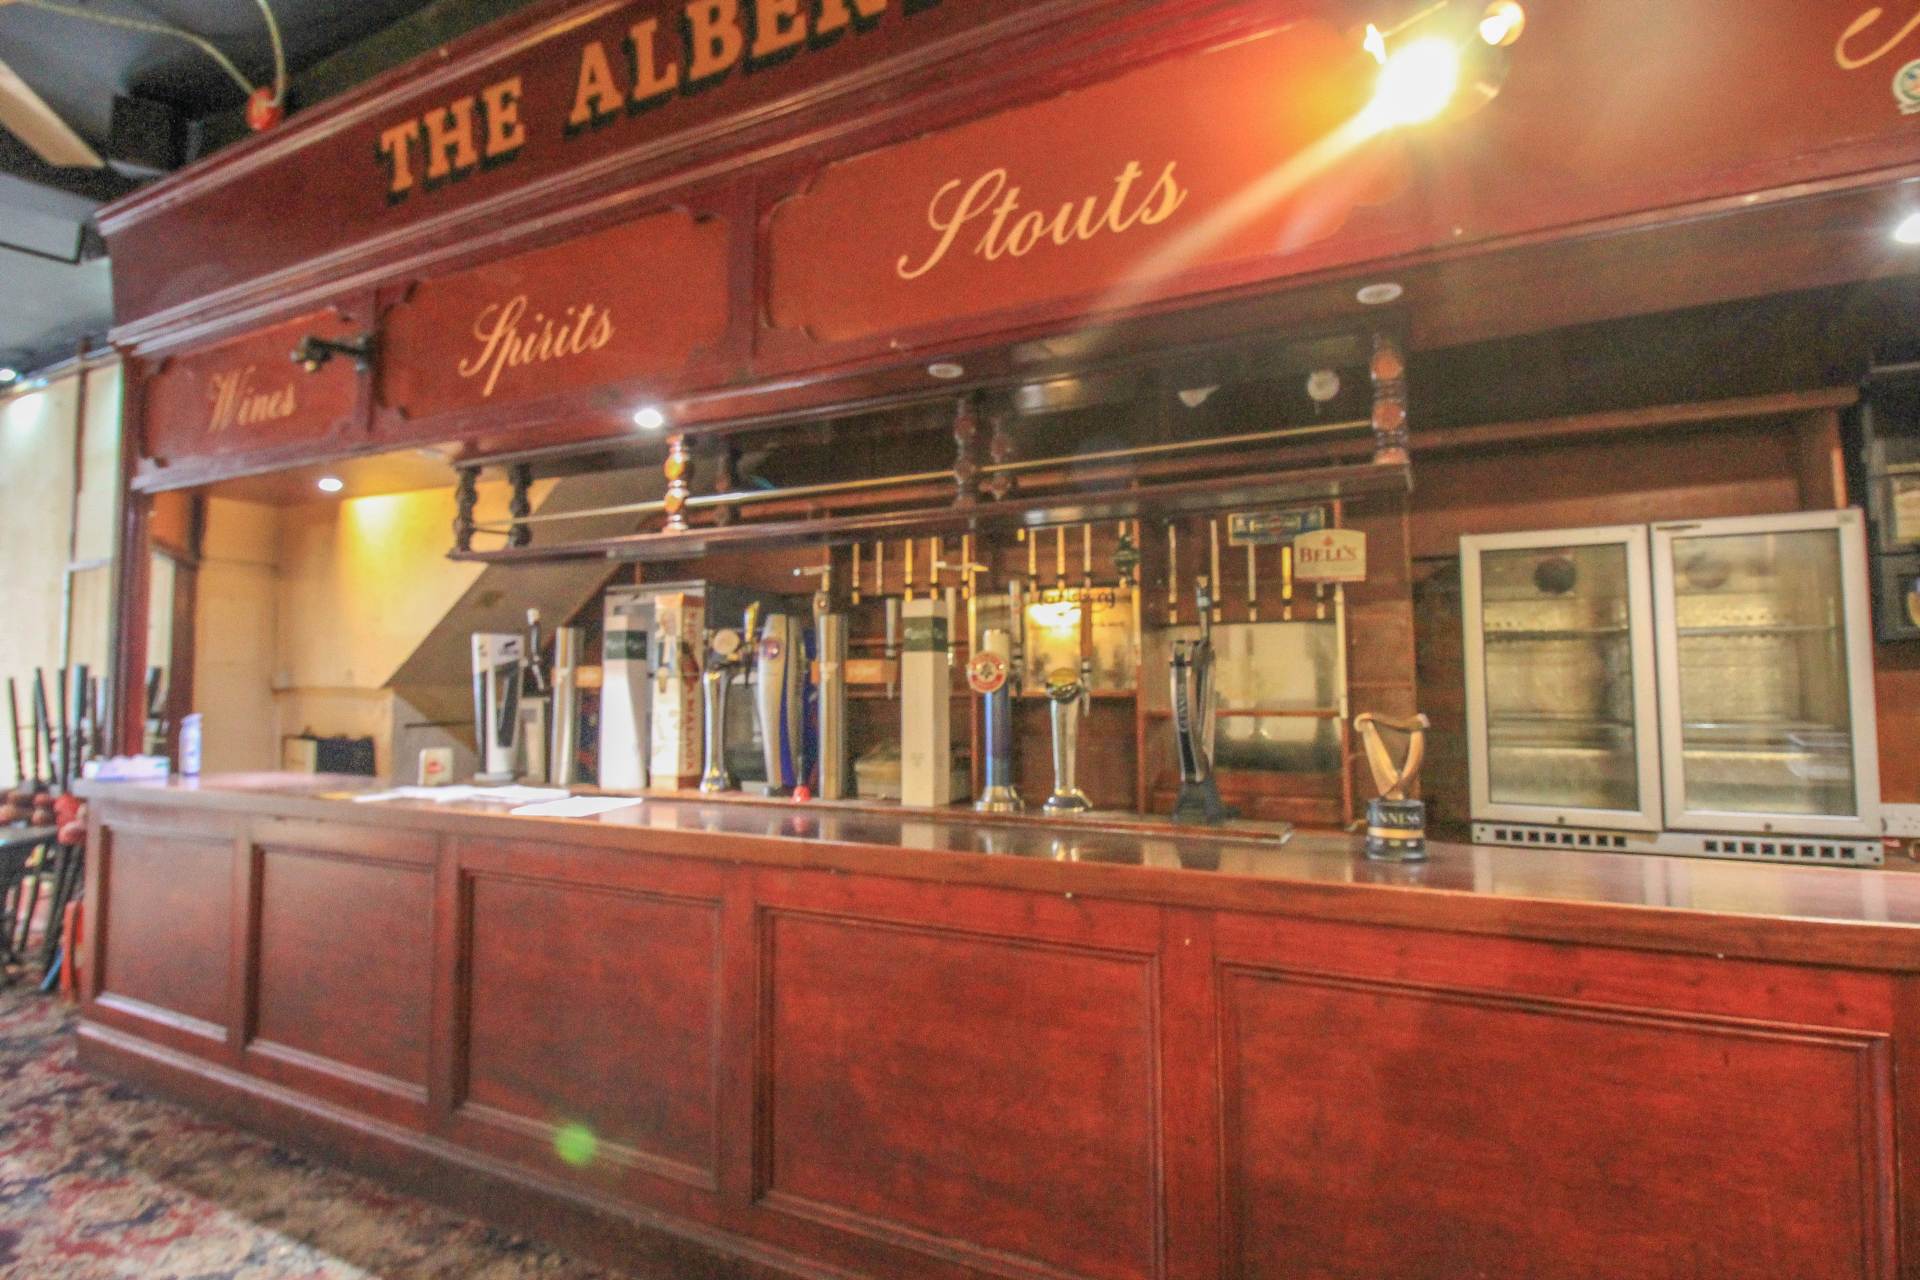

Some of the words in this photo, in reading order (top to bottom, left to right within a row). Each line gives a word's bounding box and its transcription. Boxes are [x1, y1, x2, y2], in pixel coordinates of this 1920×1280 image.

[380, 74, 526, 193] THE
[896, 160, 1188, 280] Stouts
[208, 365, 297, 434] Wines
[457, 294, 616, 398] Spirits
